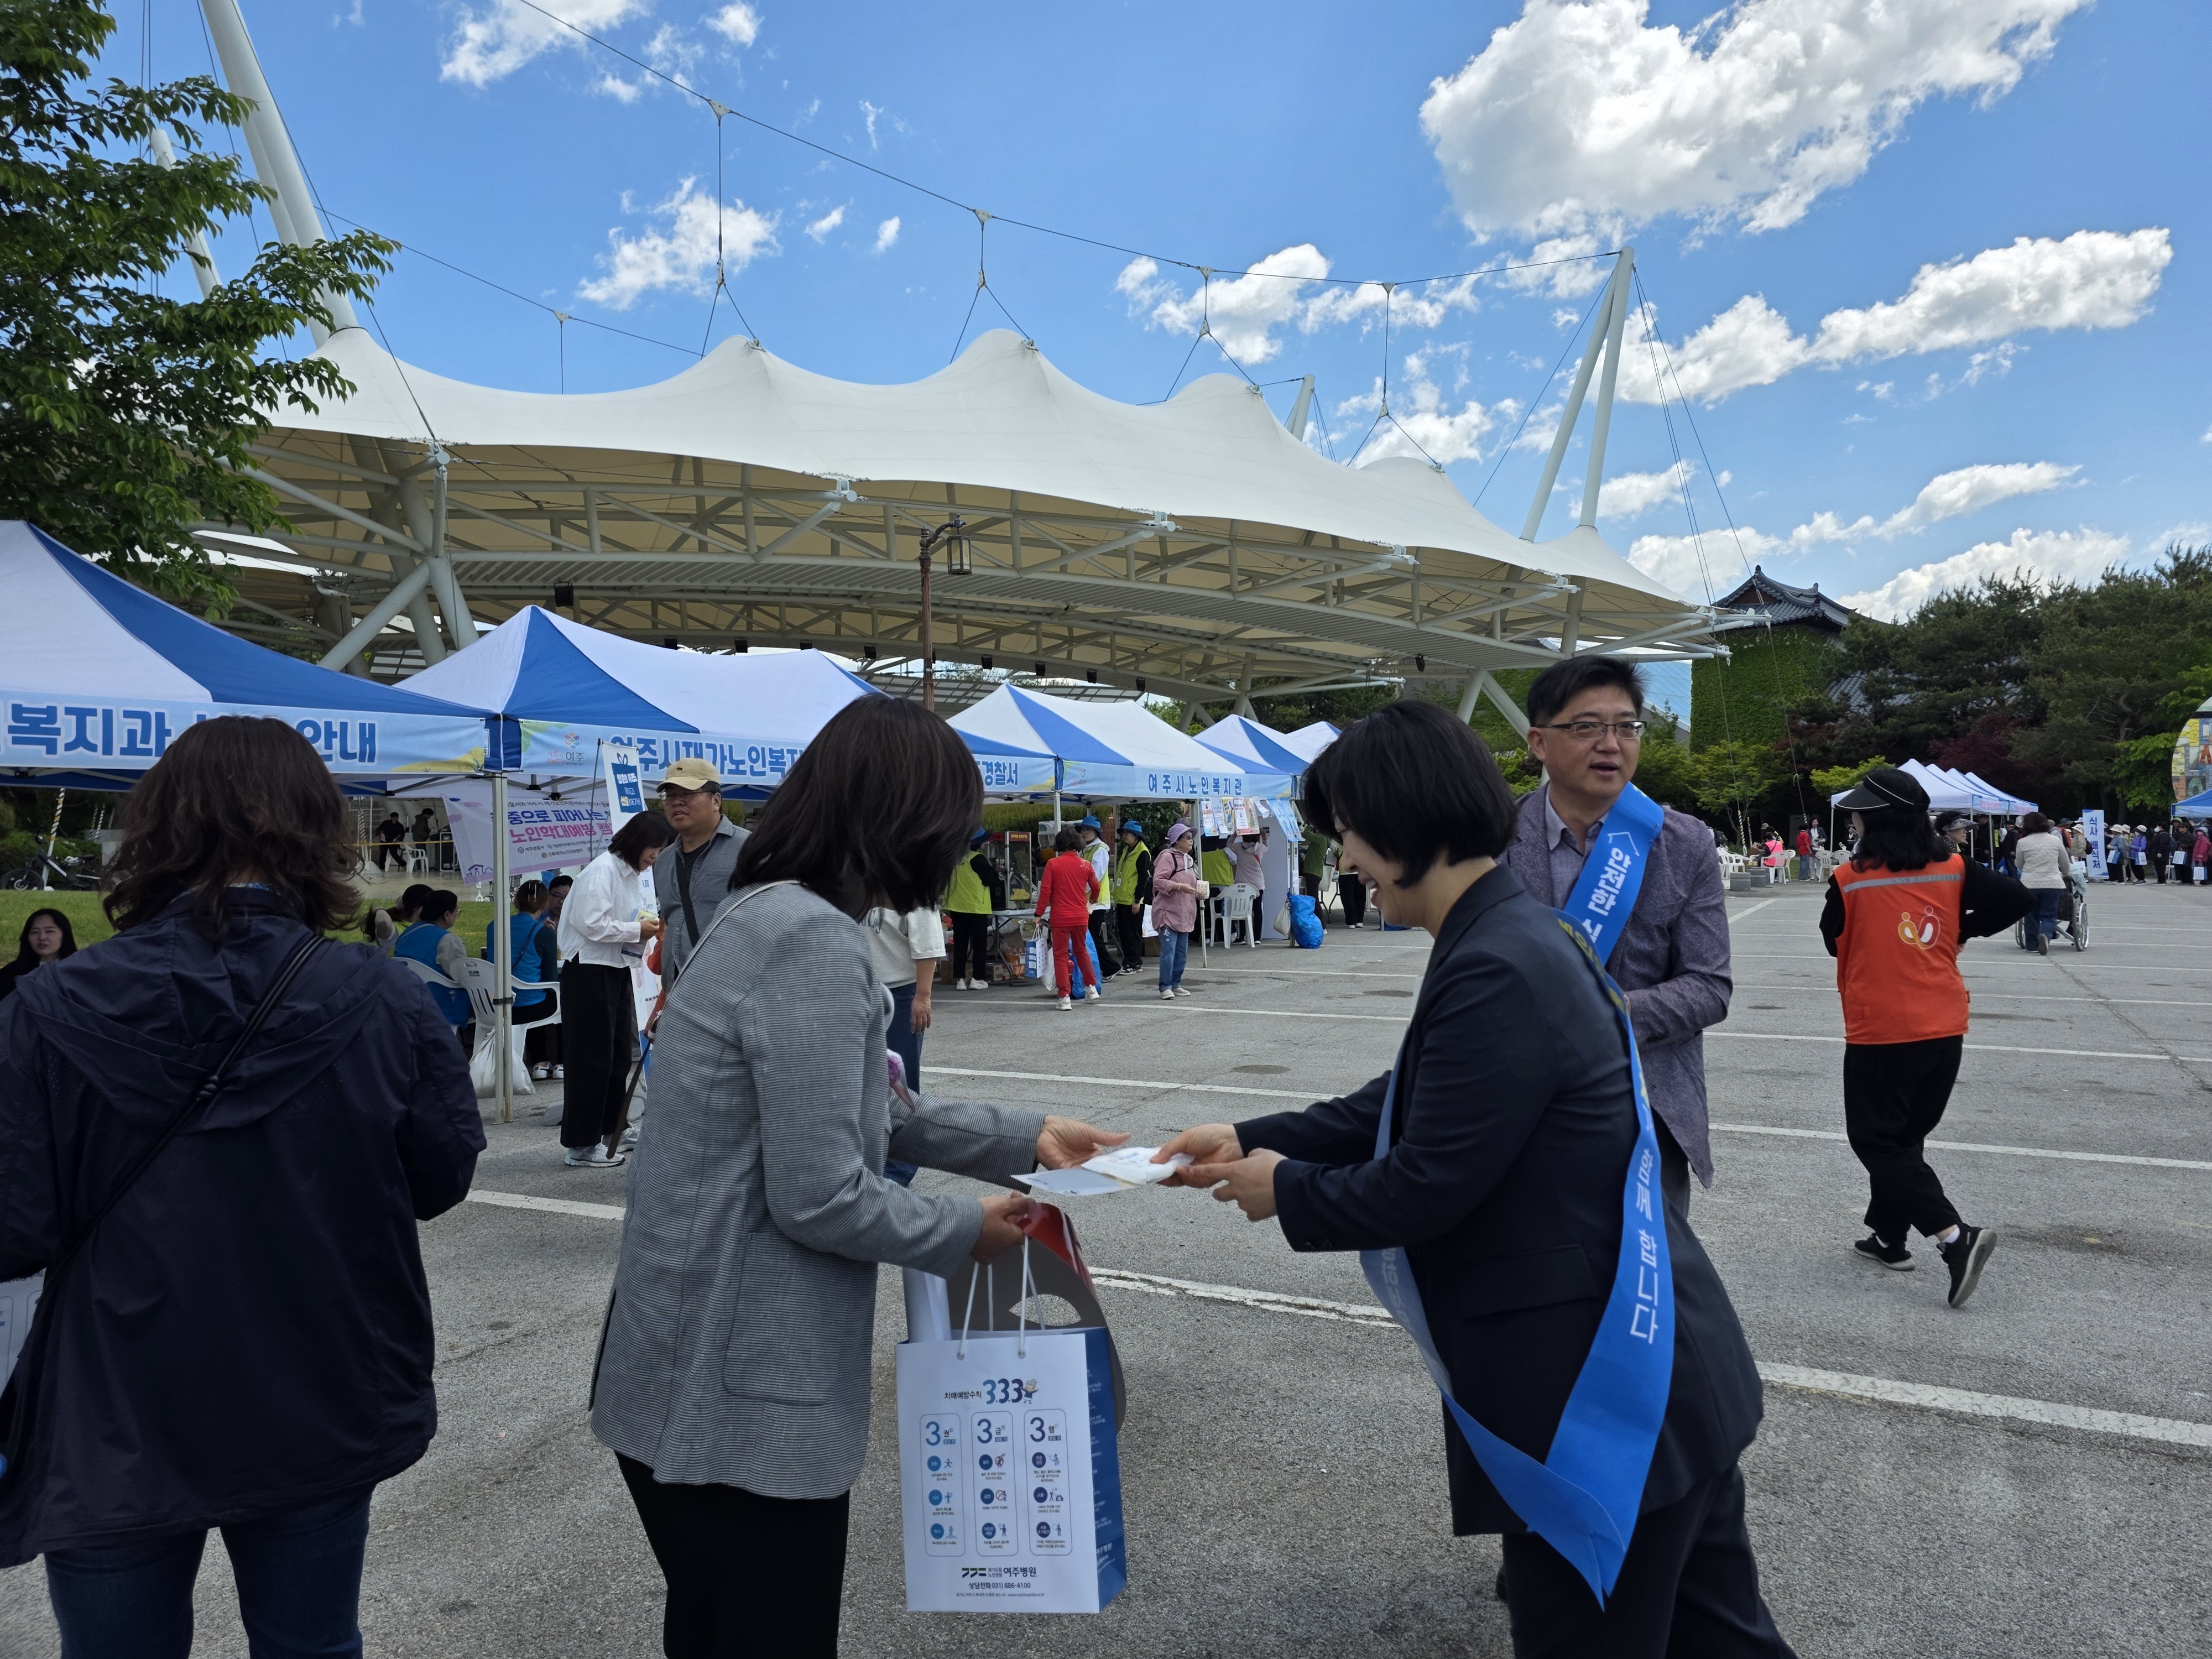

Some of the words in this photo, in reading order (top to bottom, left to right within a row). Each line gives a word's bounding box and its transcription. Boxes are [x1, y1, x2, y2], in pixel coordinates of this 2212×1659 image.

[295, 719, 376, 763] 안내
[566, 752, 584, 762] 여주
[977, 761, 1019, 786] 경찰서
[490, 810, 552, 825] 중으로
[2089, 817, 2098, 836] 식사
[1588, 847, 1631, 916] 안전한
[1636, 1149, 1653, 1222] 함께
[1630, 1229, 1658, 1344] 합니다
[944, 1390, 982, 1400] 치매예방수칙
[925, 1421, 941, 1446] 3
[977, 1418, 993, 1444] 3
[1030, 1417, 1046, 1442] 3
[1003, 1567, 1037, 1578] 여주병원
